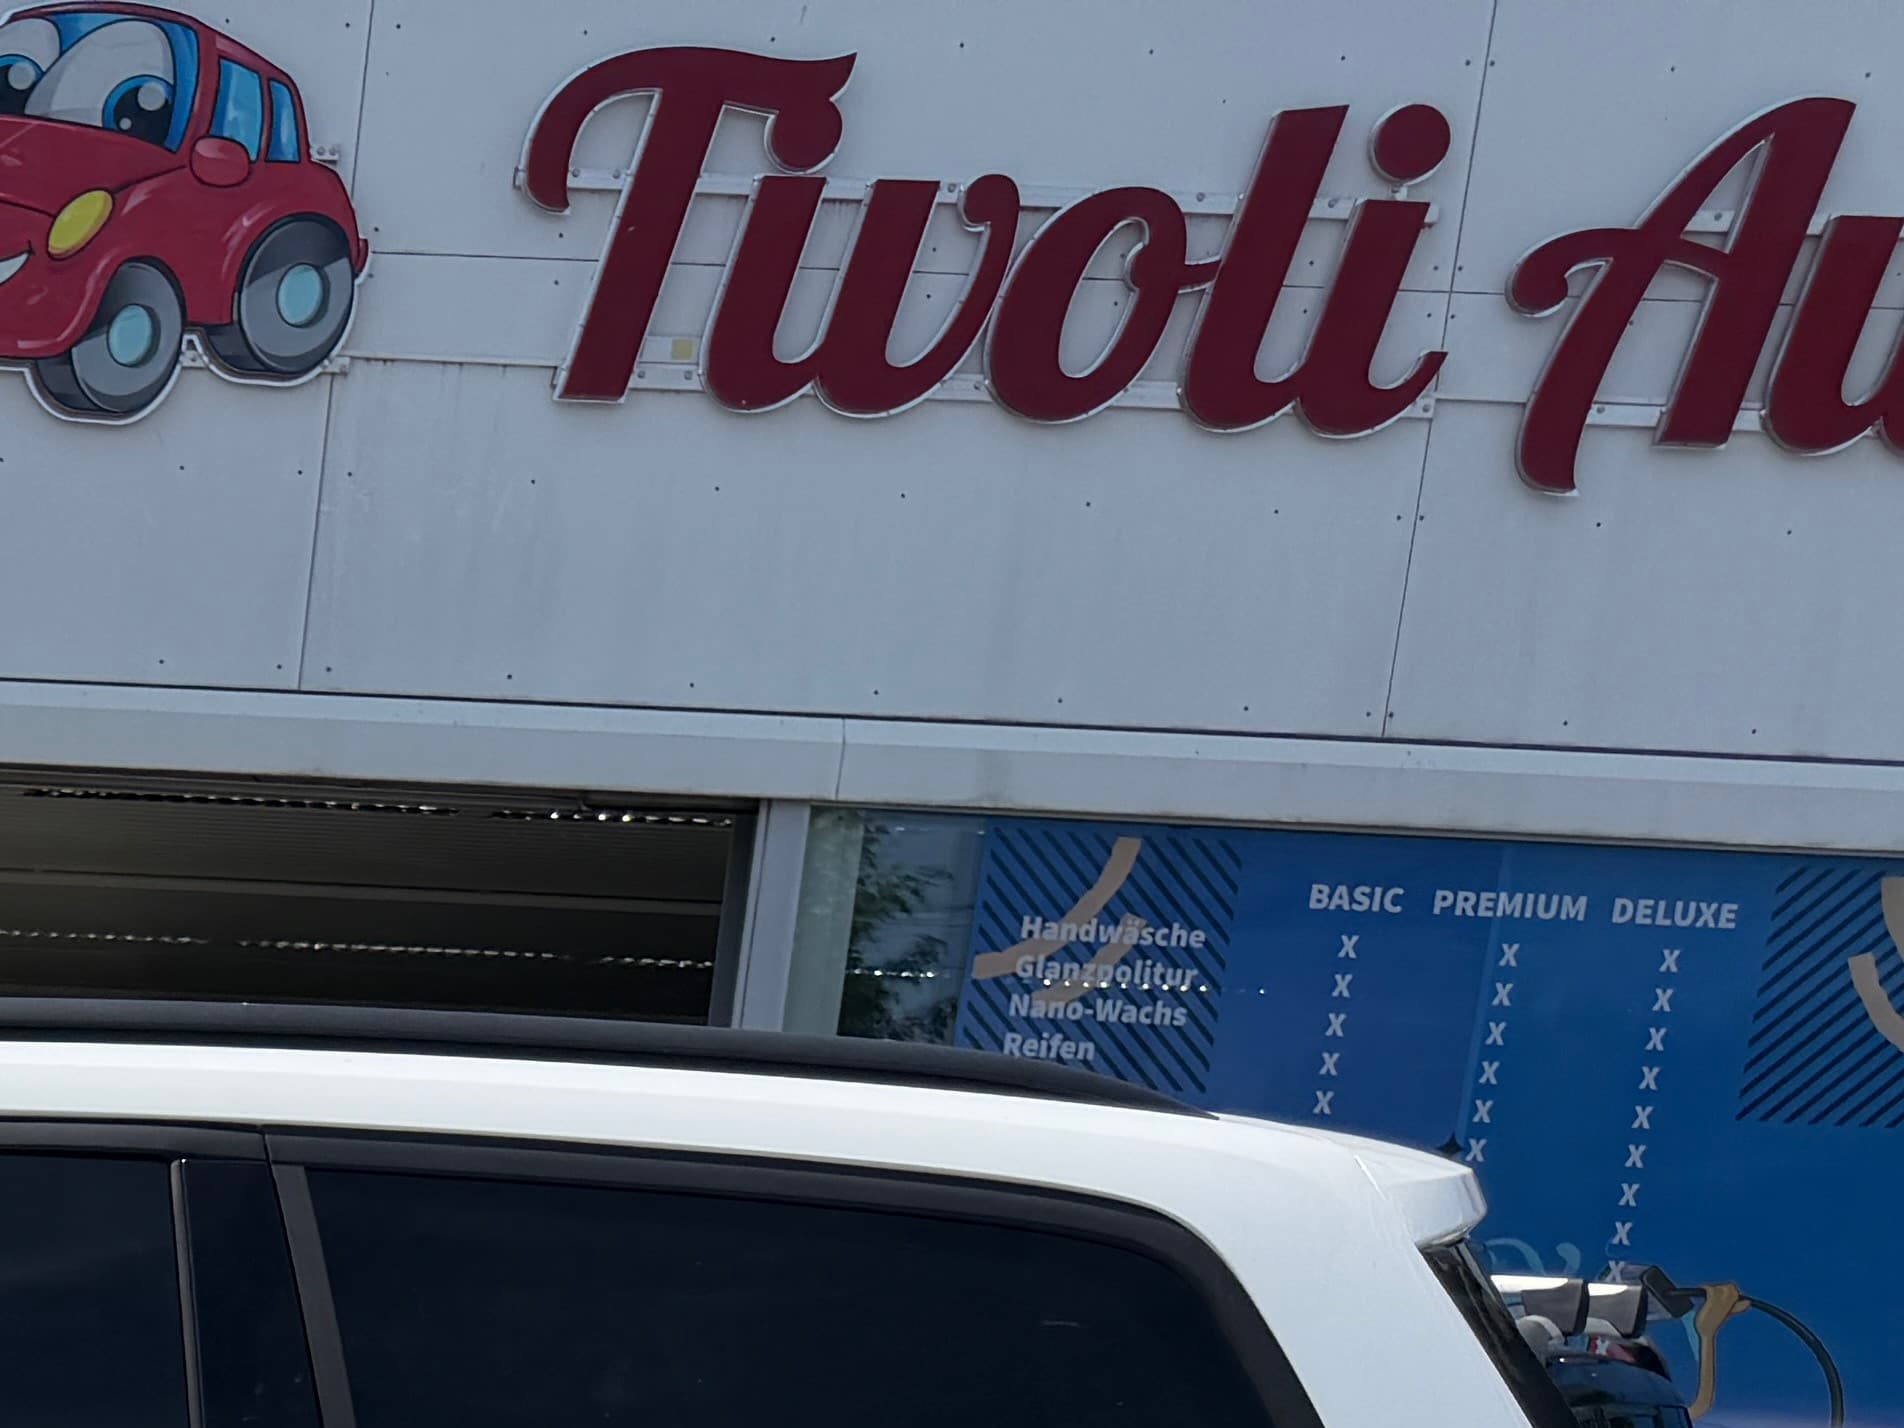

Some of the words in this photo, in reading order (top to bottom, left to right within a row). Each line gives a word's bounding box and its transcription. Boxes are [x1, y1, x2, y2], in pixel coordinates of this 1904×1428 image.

[517, 44, 1452, 440] Tivoli
[1308, 883, 1406, 914] BASIC
[1432, 889, 1589, 922] PREMIUM
[1610, 897, 1739, 930] DELUXE
[1019, 914, 1207, 949] Handwäsche
[1014, 954, 1199, 989] Glanzpolitur
[1337, 934, 1360, 960] X
[1498, 943, 1521, 968] X
[1658, 948, 1681, 973] X
[1008, 993, 1188, 1027] Nano-Wachs
[1331, 973, 1353, 999] X
[1492, 982, 1514, 1007] X
[1652, 987, 1674, 1013] X
[1002, 1031, 1097, 1061] Reifen
[1324, 1012, 1347, 1037] X
[1485, 1021, 1507, 1047] X
[1645, 1026, 1668, 1052] X
[1319, 1051, 1341, 1077] X
[1479, 1060, 1500, 1086] X
[1638, 1065, 1661, 1091] X
[1312, 1090, 1335, 1116] X
[1471, 1098, 1493, 1124] X
[1631, 1104, 1654, 1130] X
[1464, 1137, 1488, 1163] X
[1624, 1143, 1647, 1169] X
[1617, 1182, 1640, 1208] X
[1610, 1221, 1633, 1246] X
